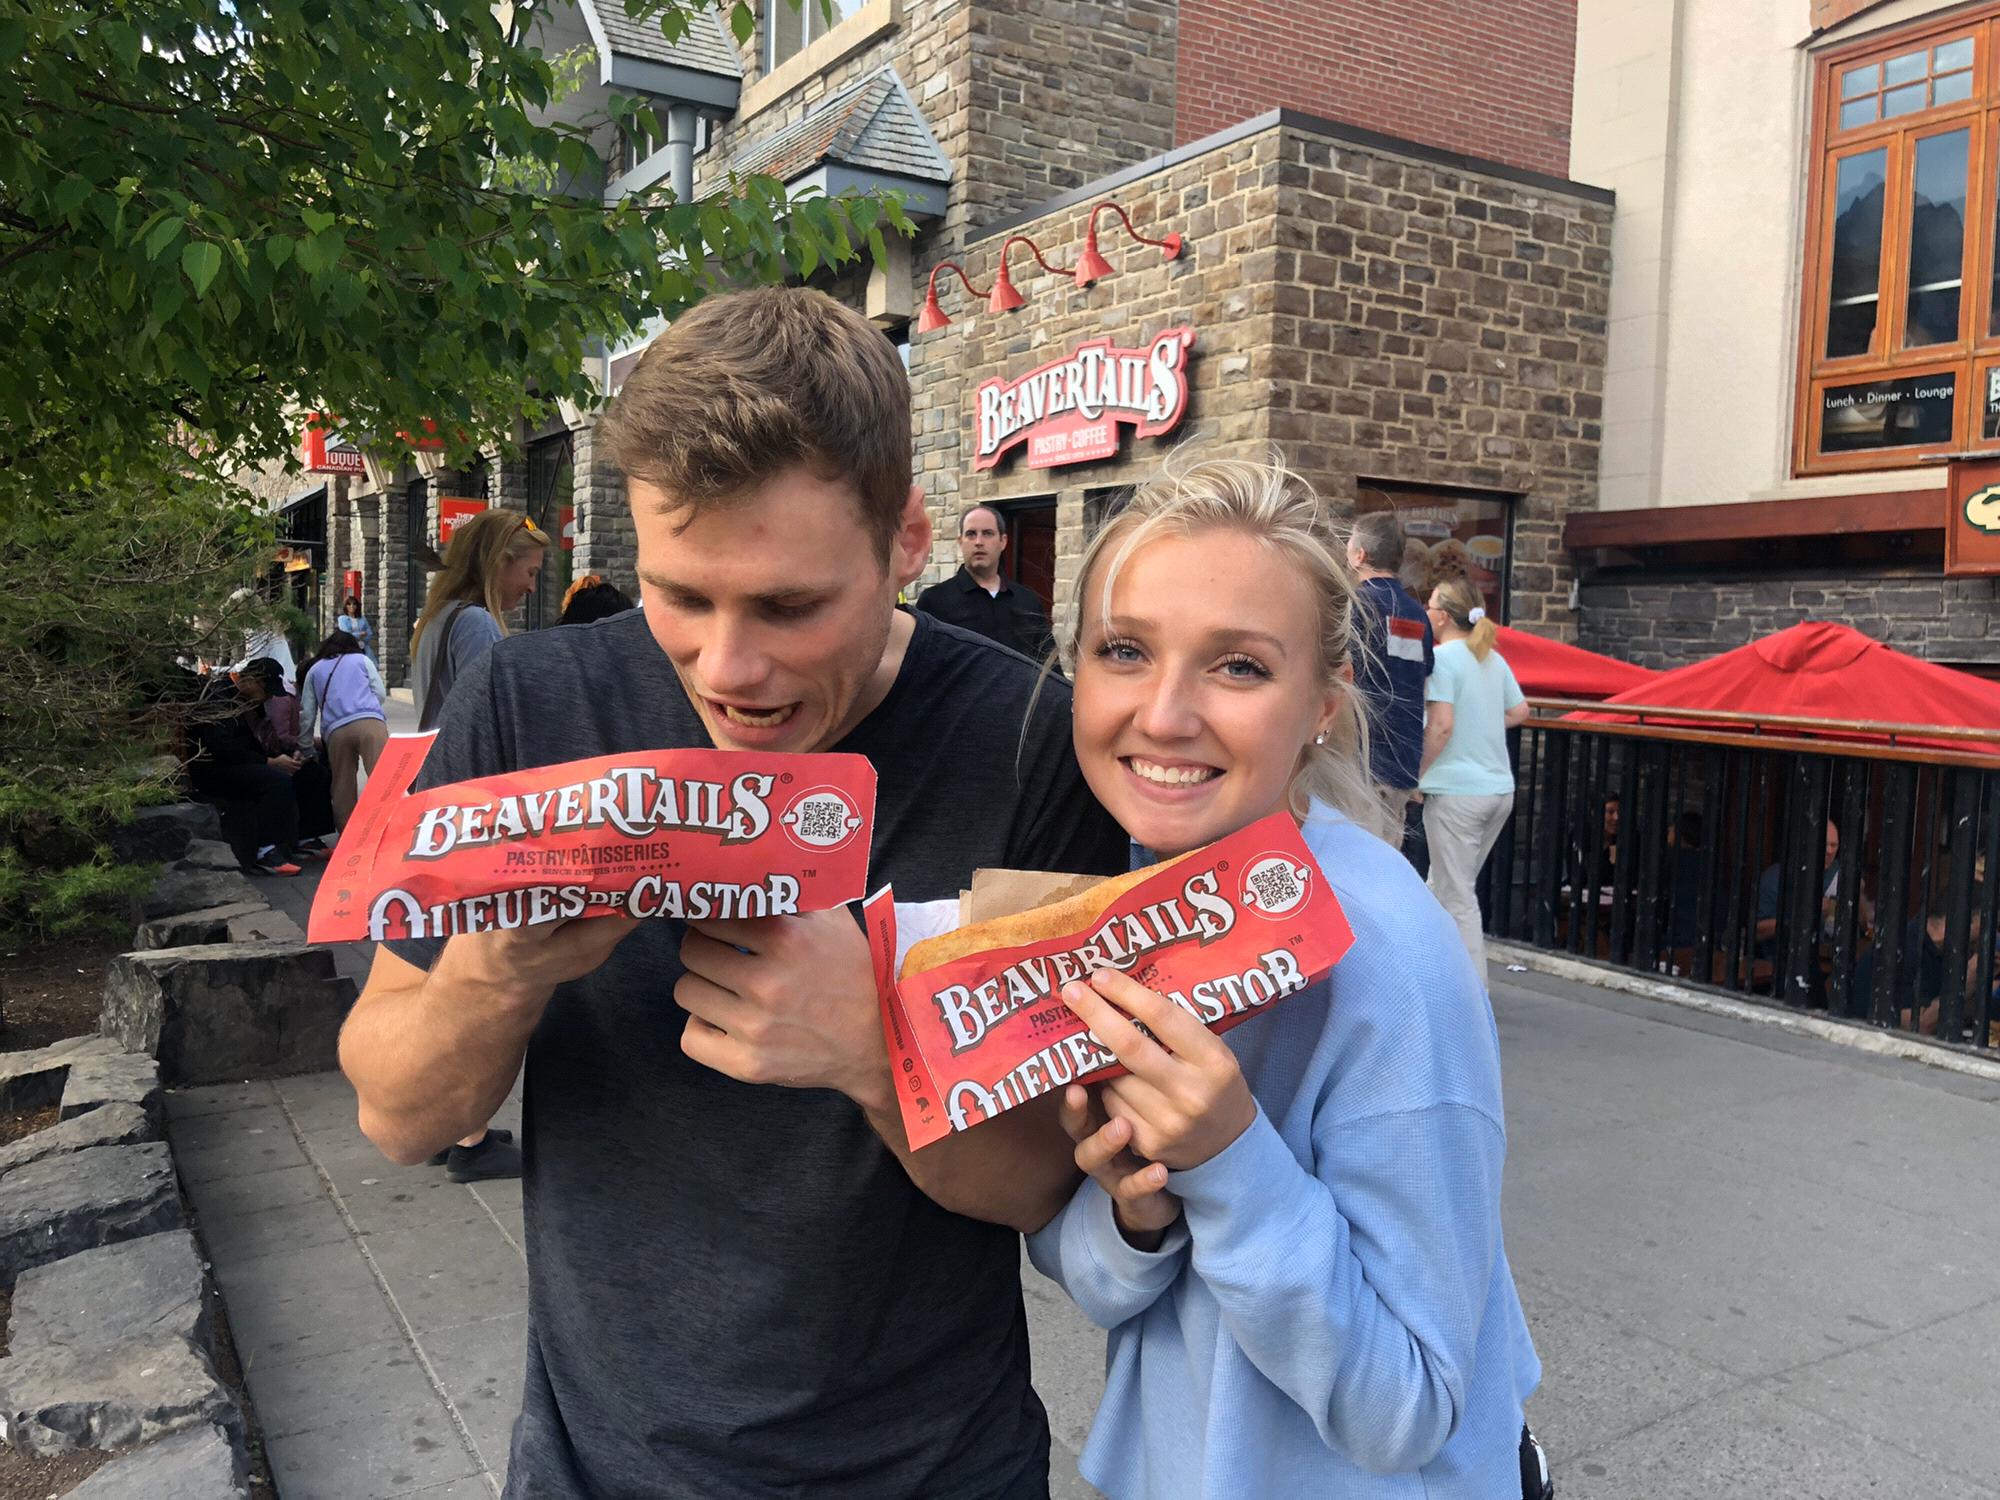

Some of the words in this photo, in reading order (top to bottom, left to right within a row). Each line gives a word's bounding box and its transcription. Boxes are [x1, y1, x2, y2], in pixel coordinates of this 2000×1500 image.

[979, 337, 1180, 456] BEAVERTAILS
[1825, 395, 1855, 409] Lunch
[1866, 391, 1902, 404] Dinner
[1914, 386, 1954, 400] Lounge
[1033, 432, 1068, 456] PASTRY
[1071, 425, 1108, 449] COFFEE
[316, 464, 353, 472] CANADIAN
[406, 766, 777, 860] BEAVERTAILS
[541, 867, 572, 876] SINCE
[574, 867, 611, 876] DEPUIS
[588, 892, 626, 908] DE
[935, 868, 1235, 1051] BEAVERTAILS
